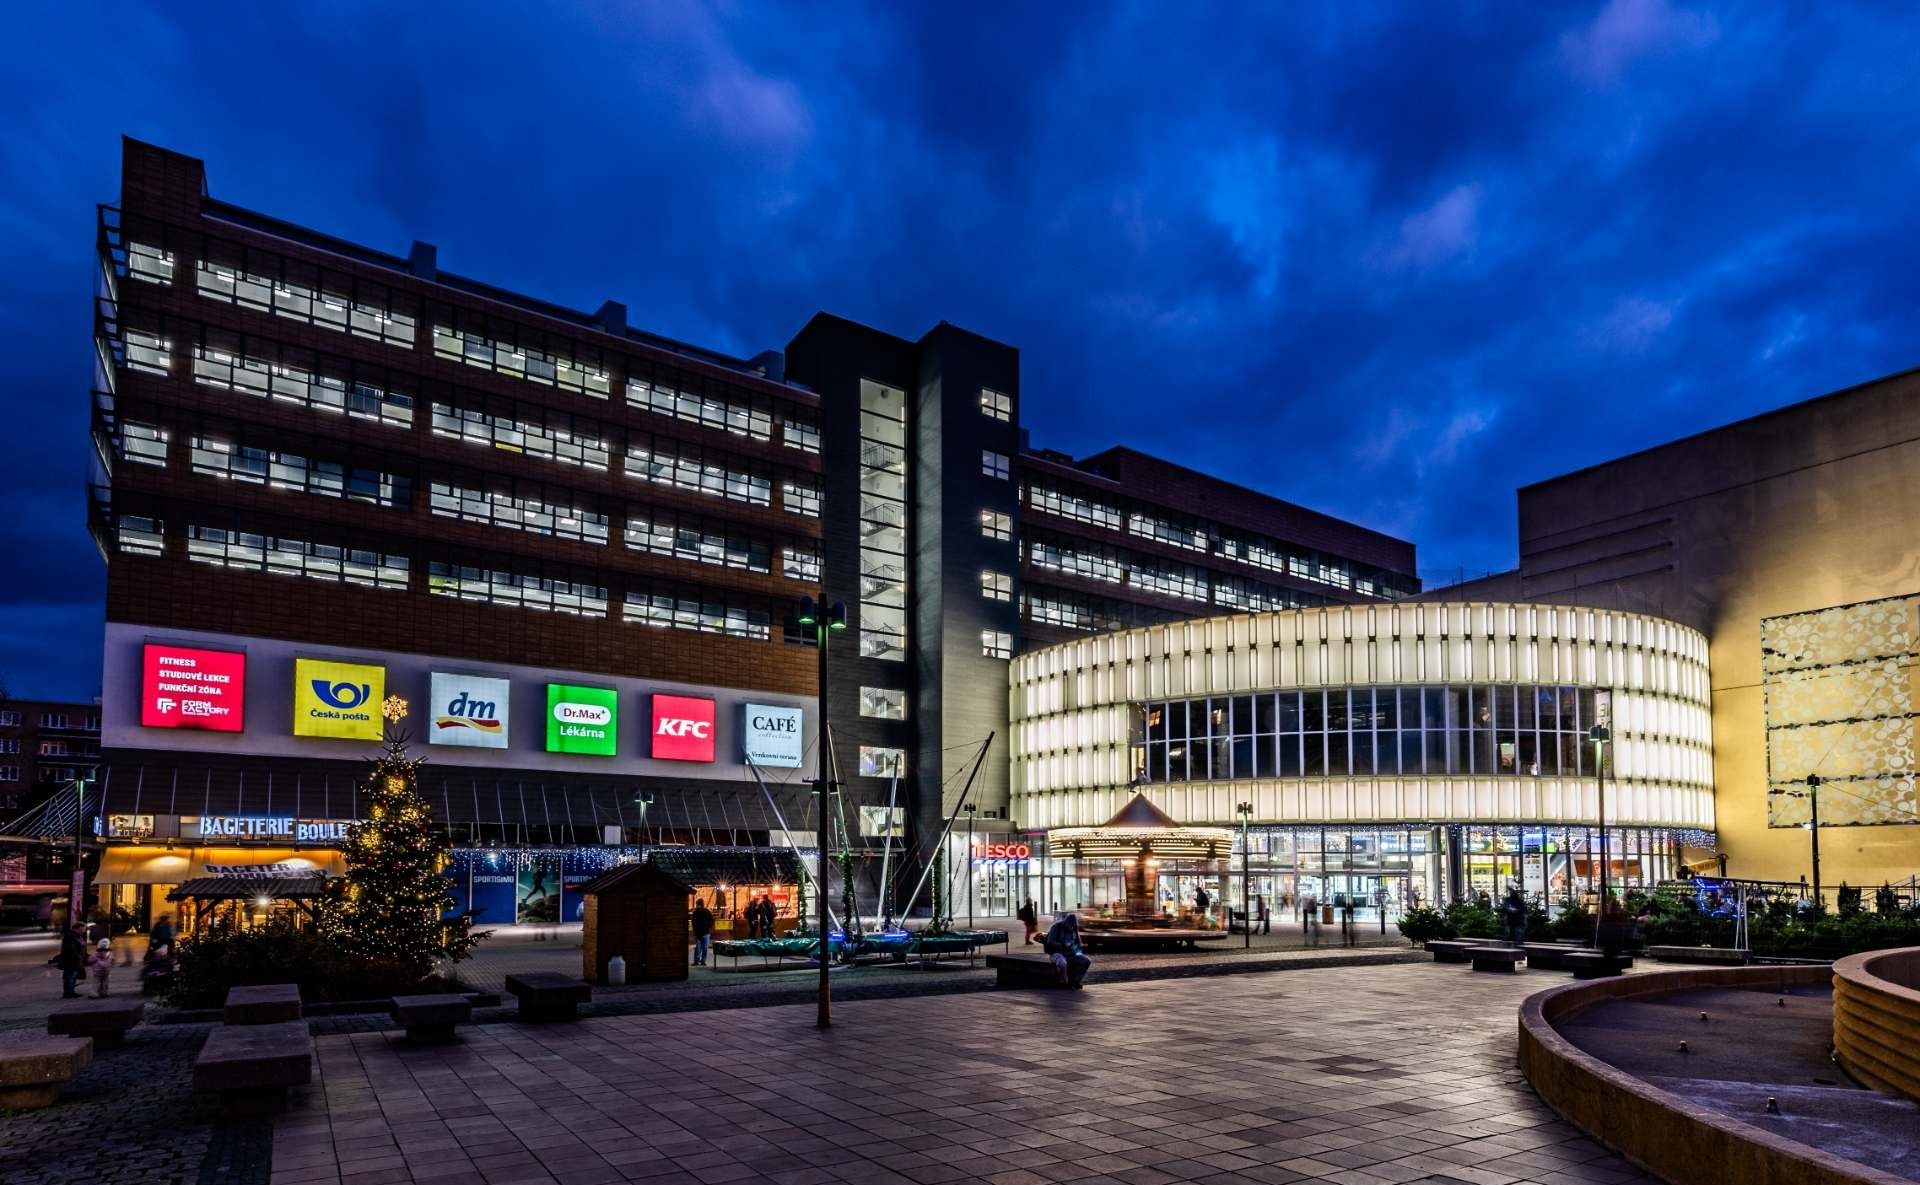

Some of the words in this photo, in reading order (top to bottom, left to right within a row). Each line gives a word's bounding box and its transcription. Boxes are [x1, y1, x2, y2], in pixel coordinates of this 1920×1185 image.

[159, 656, 196, 667] FITNESS
[158, 669, 202, 681] STUDIOVÉ
[203, 673, 230, 683] LEKCE
[158, 682, 197, 693] FUNKČNÍ
[198, 685, 222, 695] ZÓNA
[181, 699, 211, 709] FORM
[181, 705, 230, 716] FACTORY
[447, 691, 496, 719] dm
[310, 707, 340, 719] Česká
[342, 712, 370, 721] pošta
[656, 717, 711, 739] KFC
[752, 715, 797, 733] CAFÉ
[559, 725, 605, 739] Lékárna
[200, 817, 293, 835] BAGETERIE
[297, 823, 347, 840] BOULE
[974, 844, 1030, 859] TESCO
[205, 863, 289, 875] BAGETER
